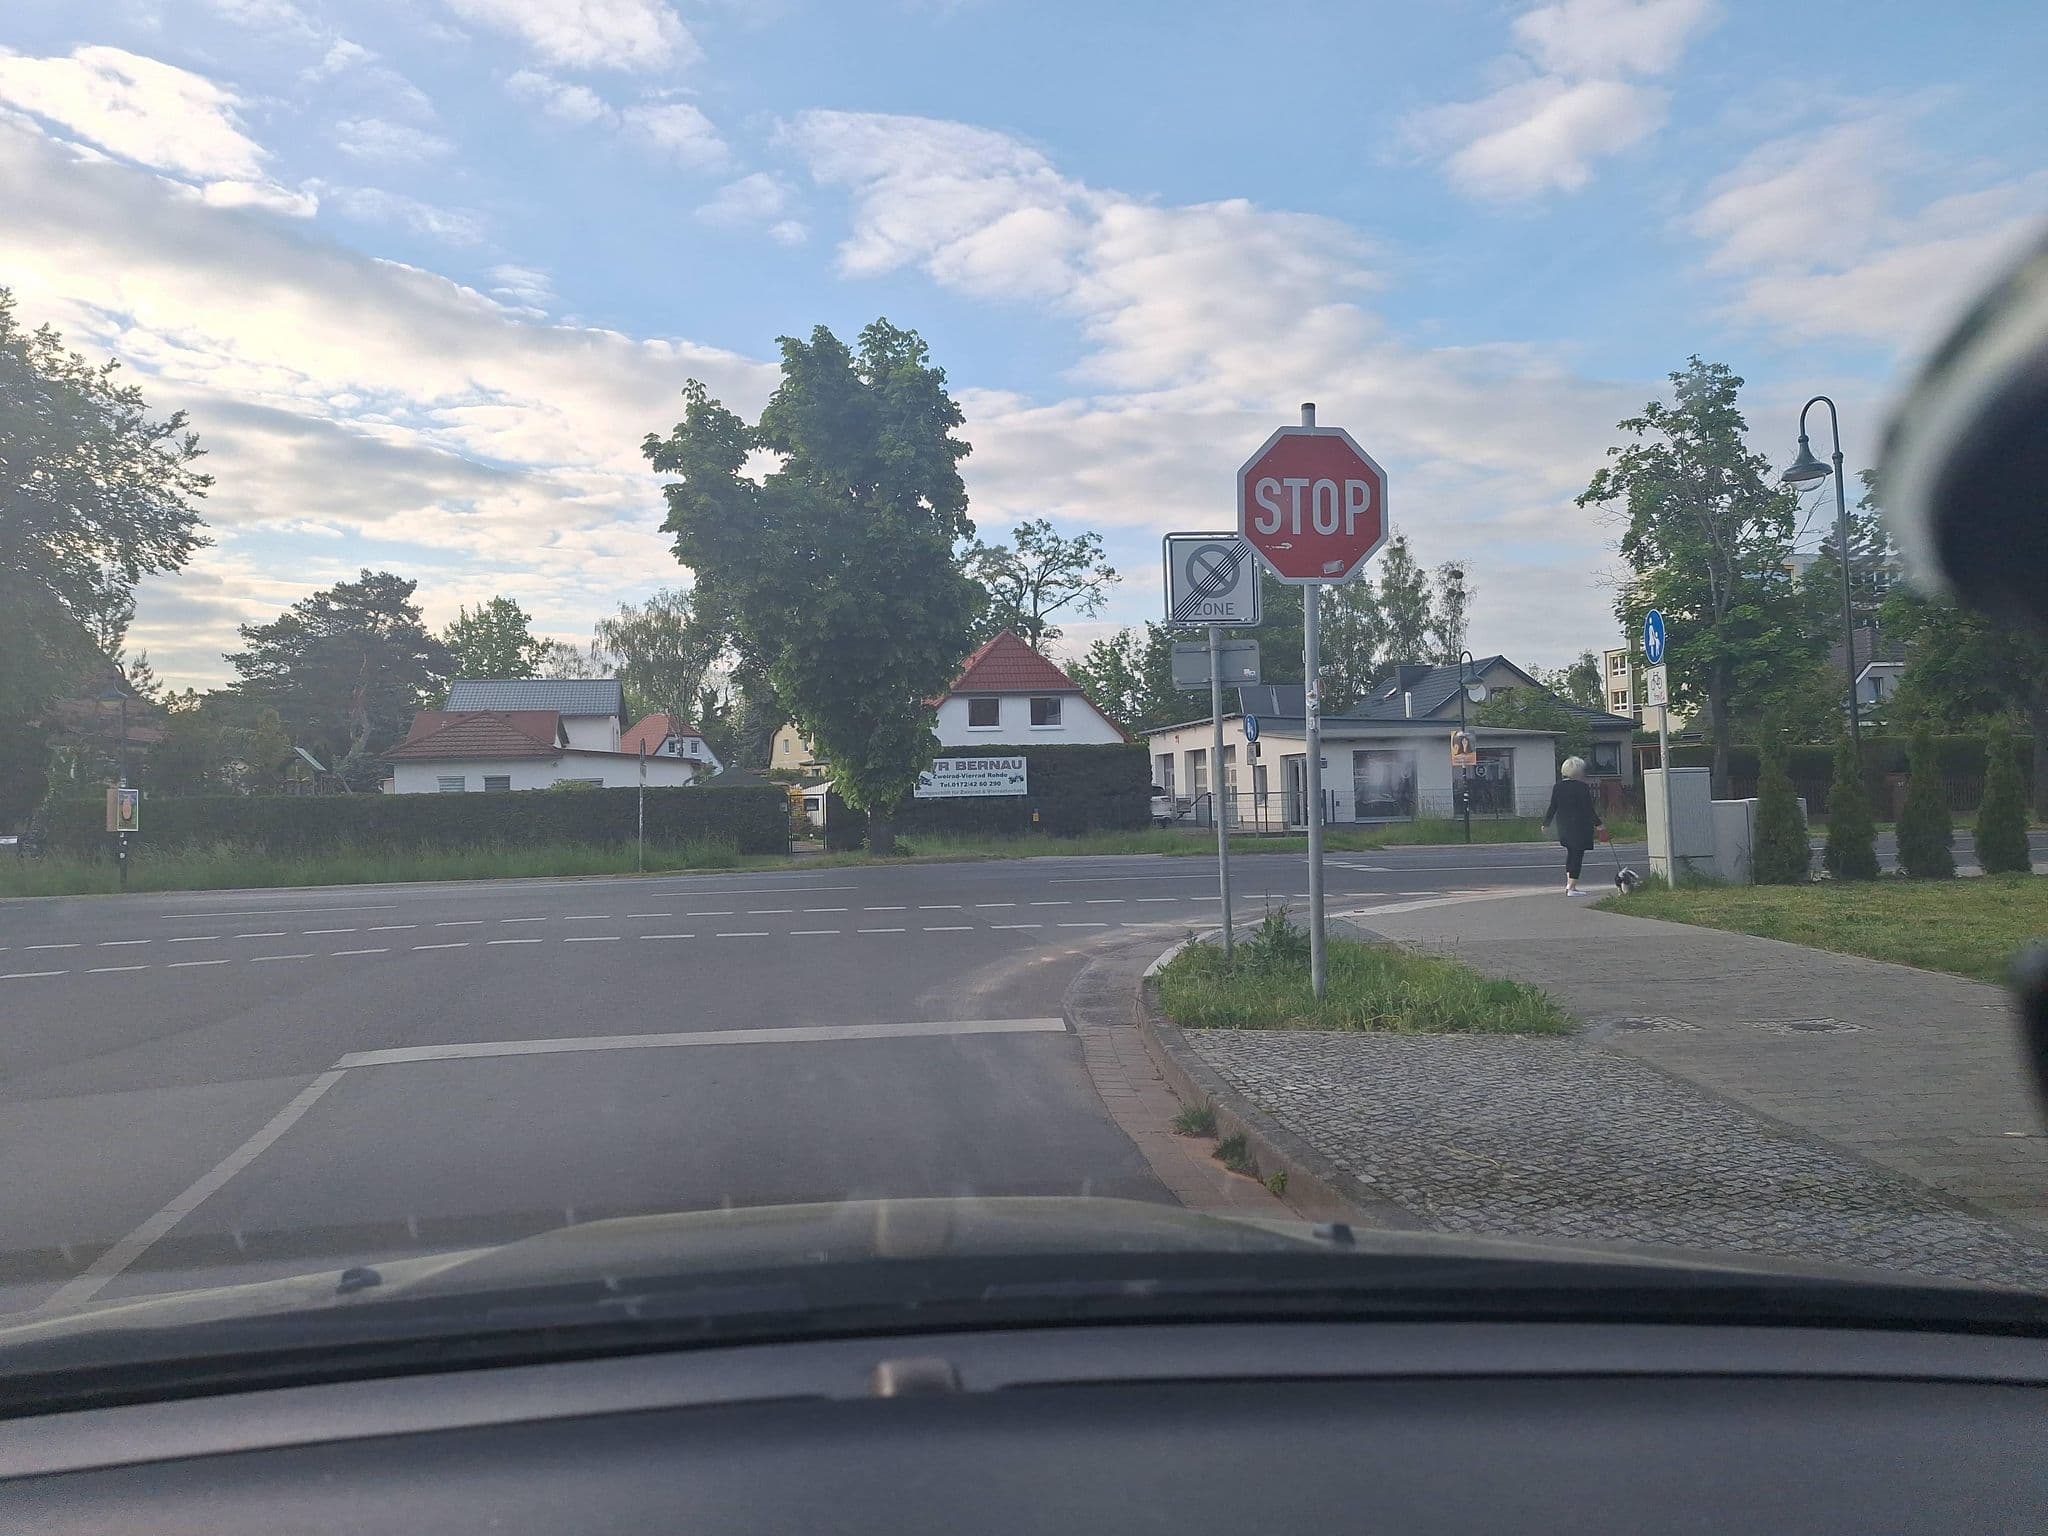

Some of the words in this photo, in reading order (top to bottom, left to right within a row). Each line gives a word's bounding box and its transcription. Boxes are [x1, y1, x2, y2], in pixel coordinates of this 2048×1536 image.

[1254, 477, 1371, 536] STOP
[1194, 602, 1235, 616] ZONE
[955, 760, 1022, 771] BERNAU
